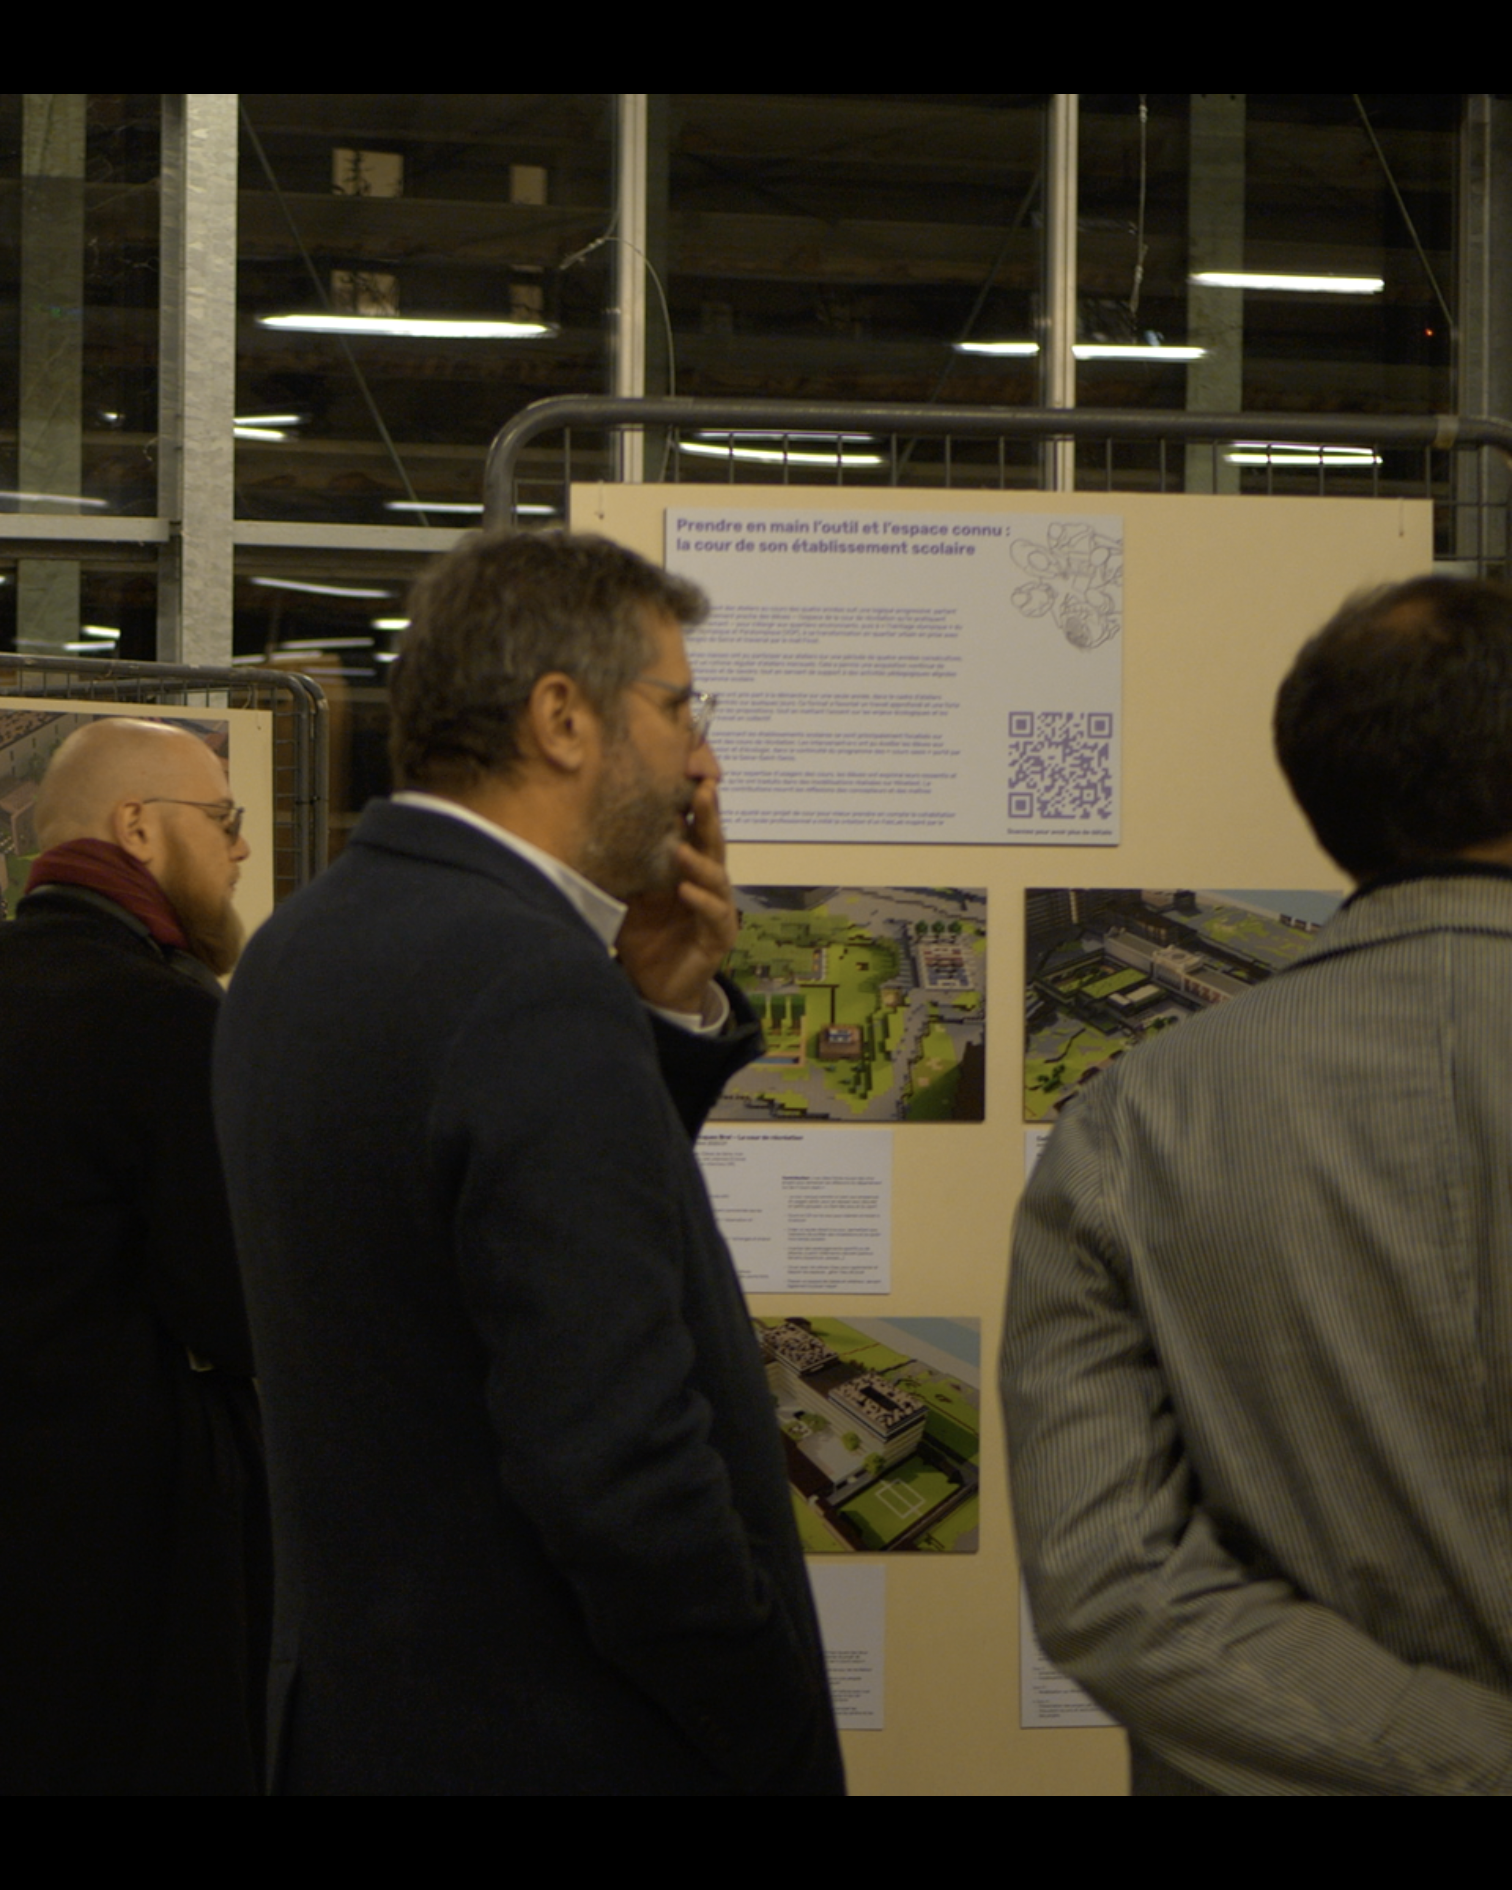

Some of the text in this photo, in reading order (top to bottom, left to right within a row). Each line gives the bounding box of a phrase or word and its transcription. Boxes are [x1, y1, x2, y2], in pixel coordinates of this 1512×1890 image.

[677, 518, 744, 533] Prendre
[746, 523, 767, 533] en
[769, 519, 811, 534] main
[812, 520, 859, 535] l'outil
[861, 521, 880, 535] et
[882, 522, 950, 539] l'espace
[952, 526, 1004, 537] connu
[676, 538, 977, 556] la cour de son établissement scolaire
